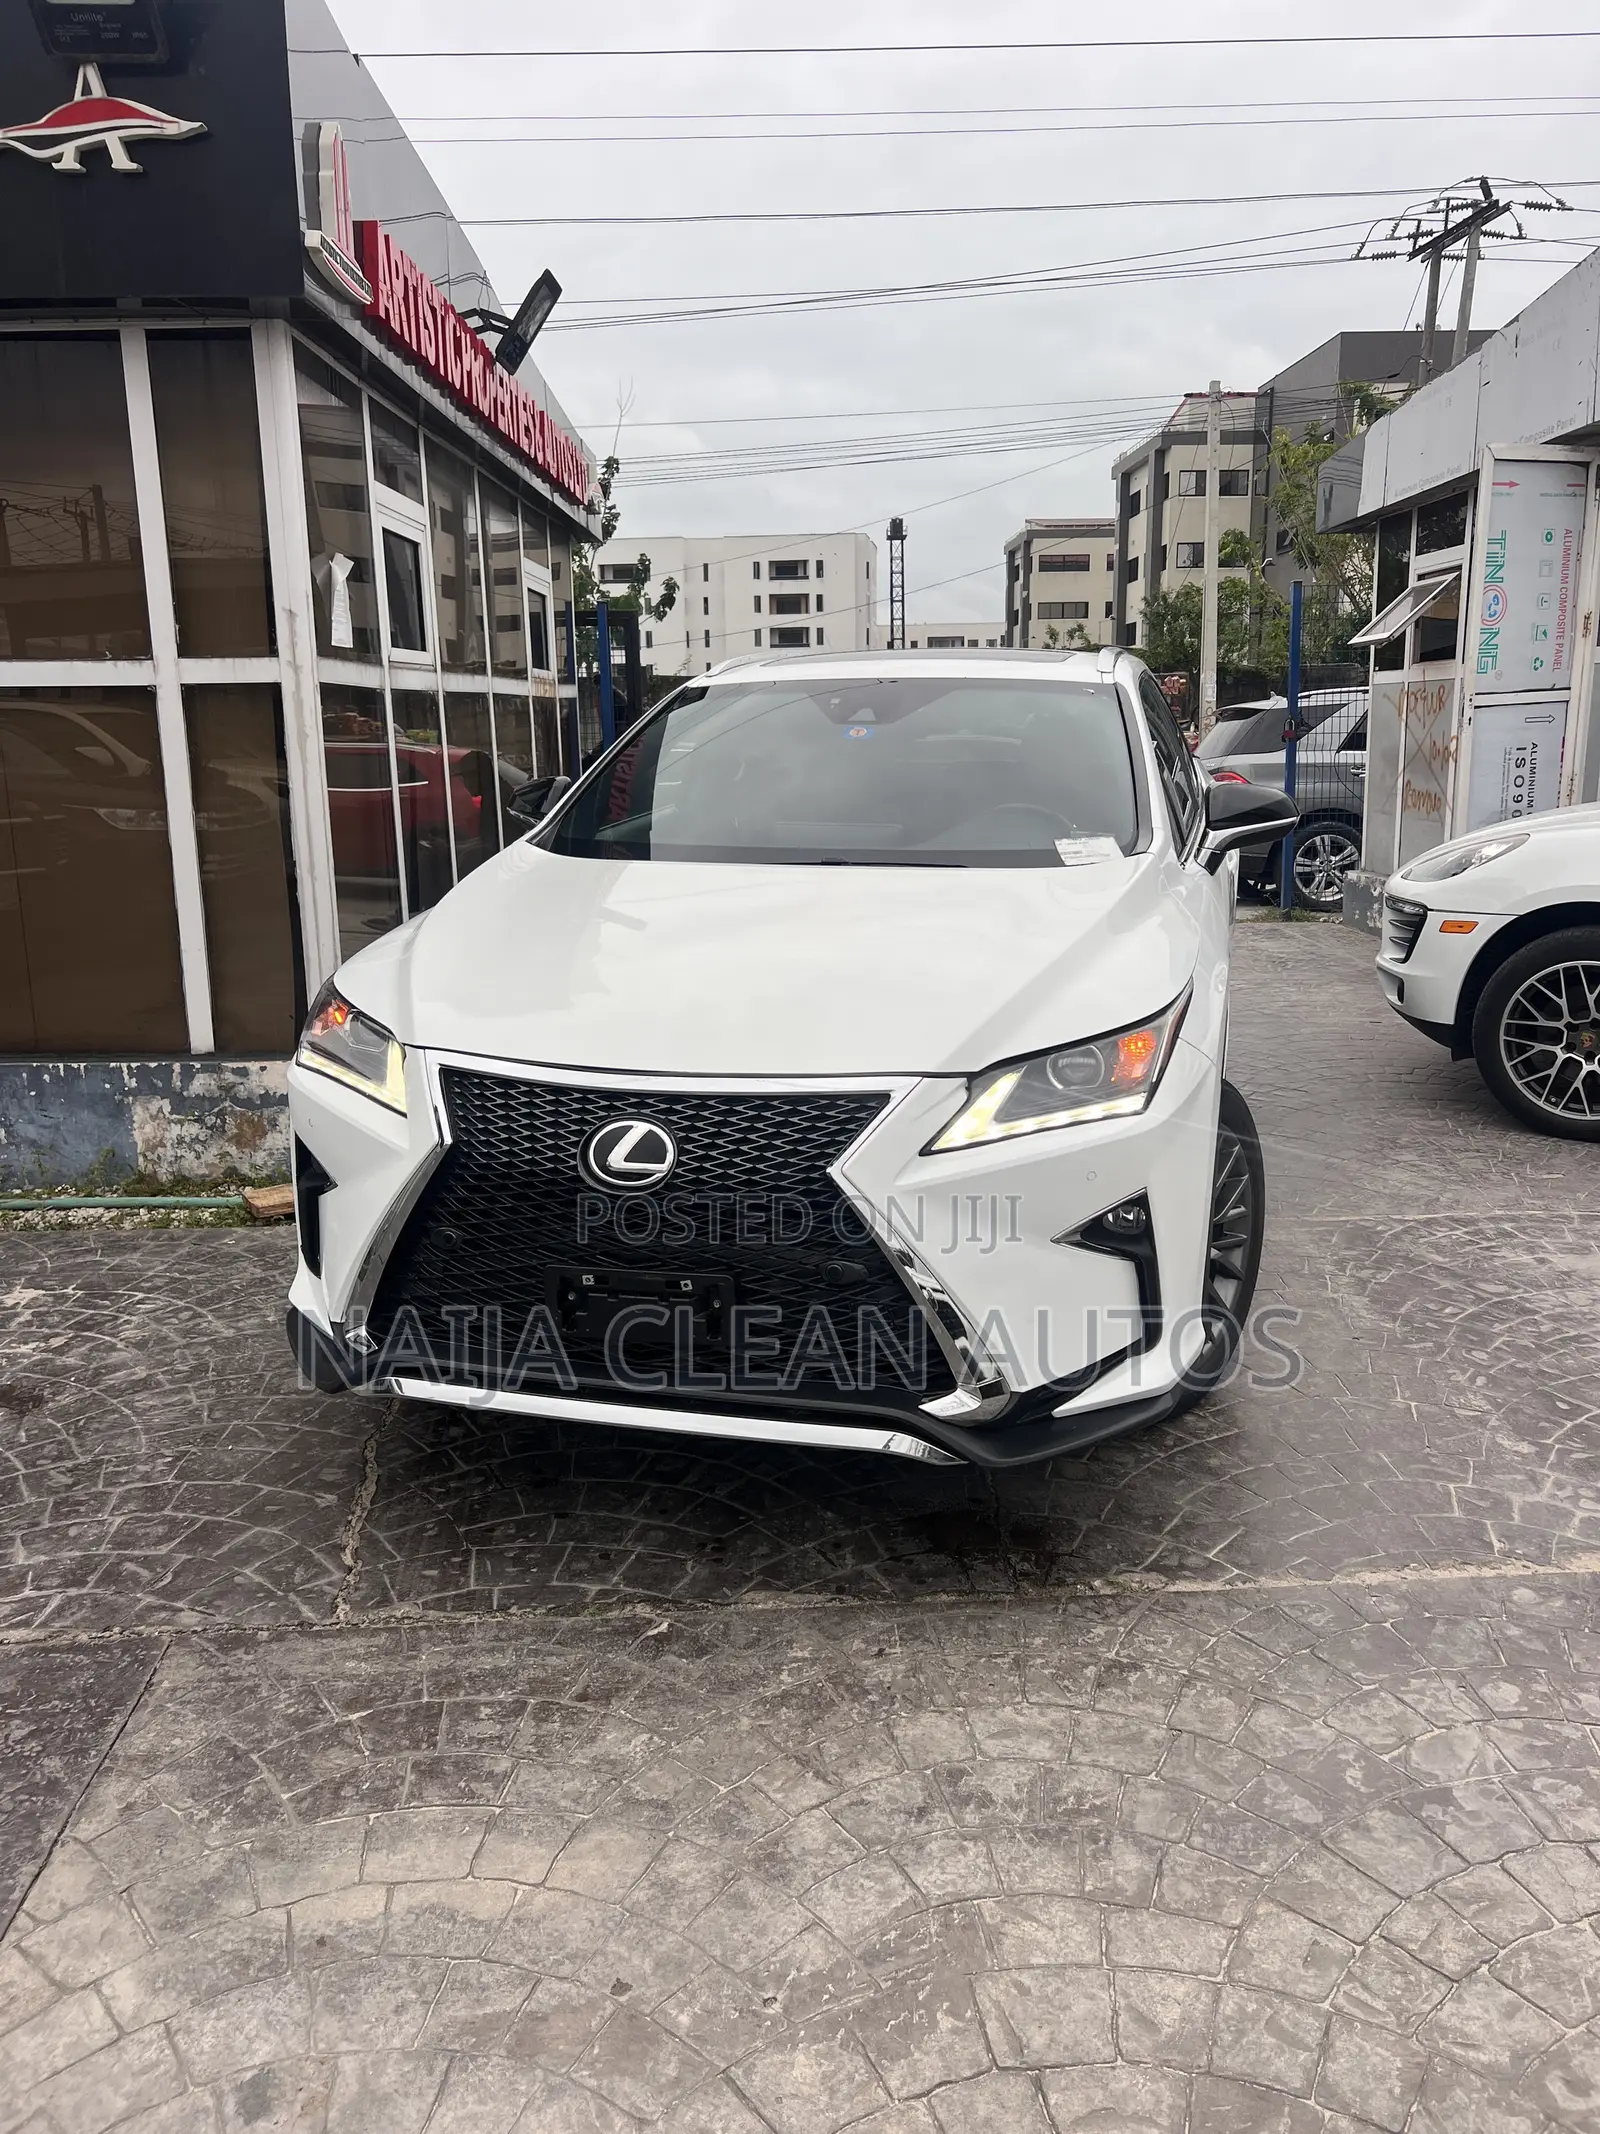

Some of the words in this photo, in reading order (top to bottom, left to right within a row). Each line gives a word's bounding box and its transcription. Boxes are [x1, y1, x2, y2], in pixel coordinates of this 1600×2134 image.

[378, 220, 461, 390] ARTISTIC
[1560, 528, 1573, 585] ALUMINIUM
[1556, 586, 1568, 641] COMPOSITE
[1552, 643, 1564, 672] PANEL
[1526, 741, 1538, 809] ALUMINIUM
